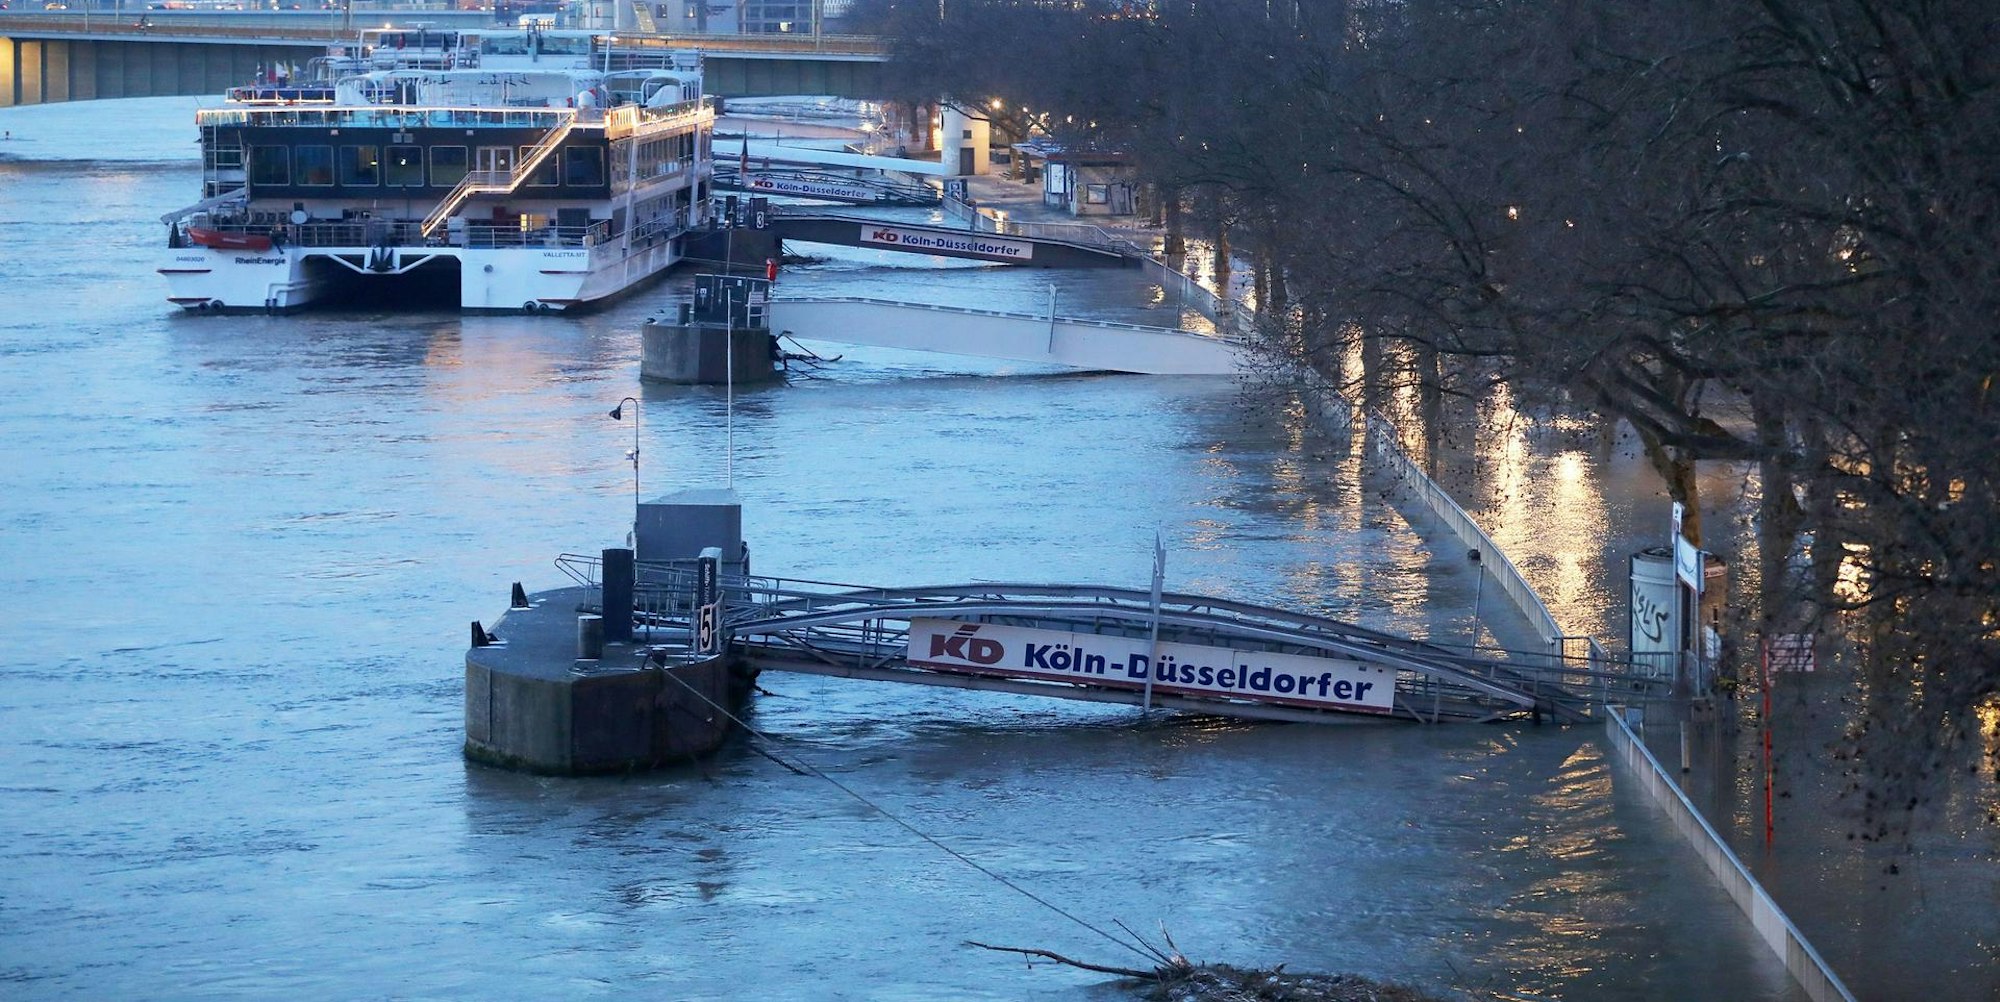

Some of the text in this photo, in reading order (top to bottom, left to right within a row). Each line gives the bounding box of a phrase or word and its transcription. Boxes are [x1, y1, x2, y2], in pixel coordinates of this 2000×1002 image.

[754, 178, 867, 198] KD Köln-Düsseldorfer
[757, 212, 764, 228] 3
[872, 228, 1020, 256] KD Köln-Düsseldorfer
[235, 256, 286, 266] RheinEnergie
[702, 608, 710, 648] 5
[930, 624, 1374, 701] KD Köln-Düsseldorfer
